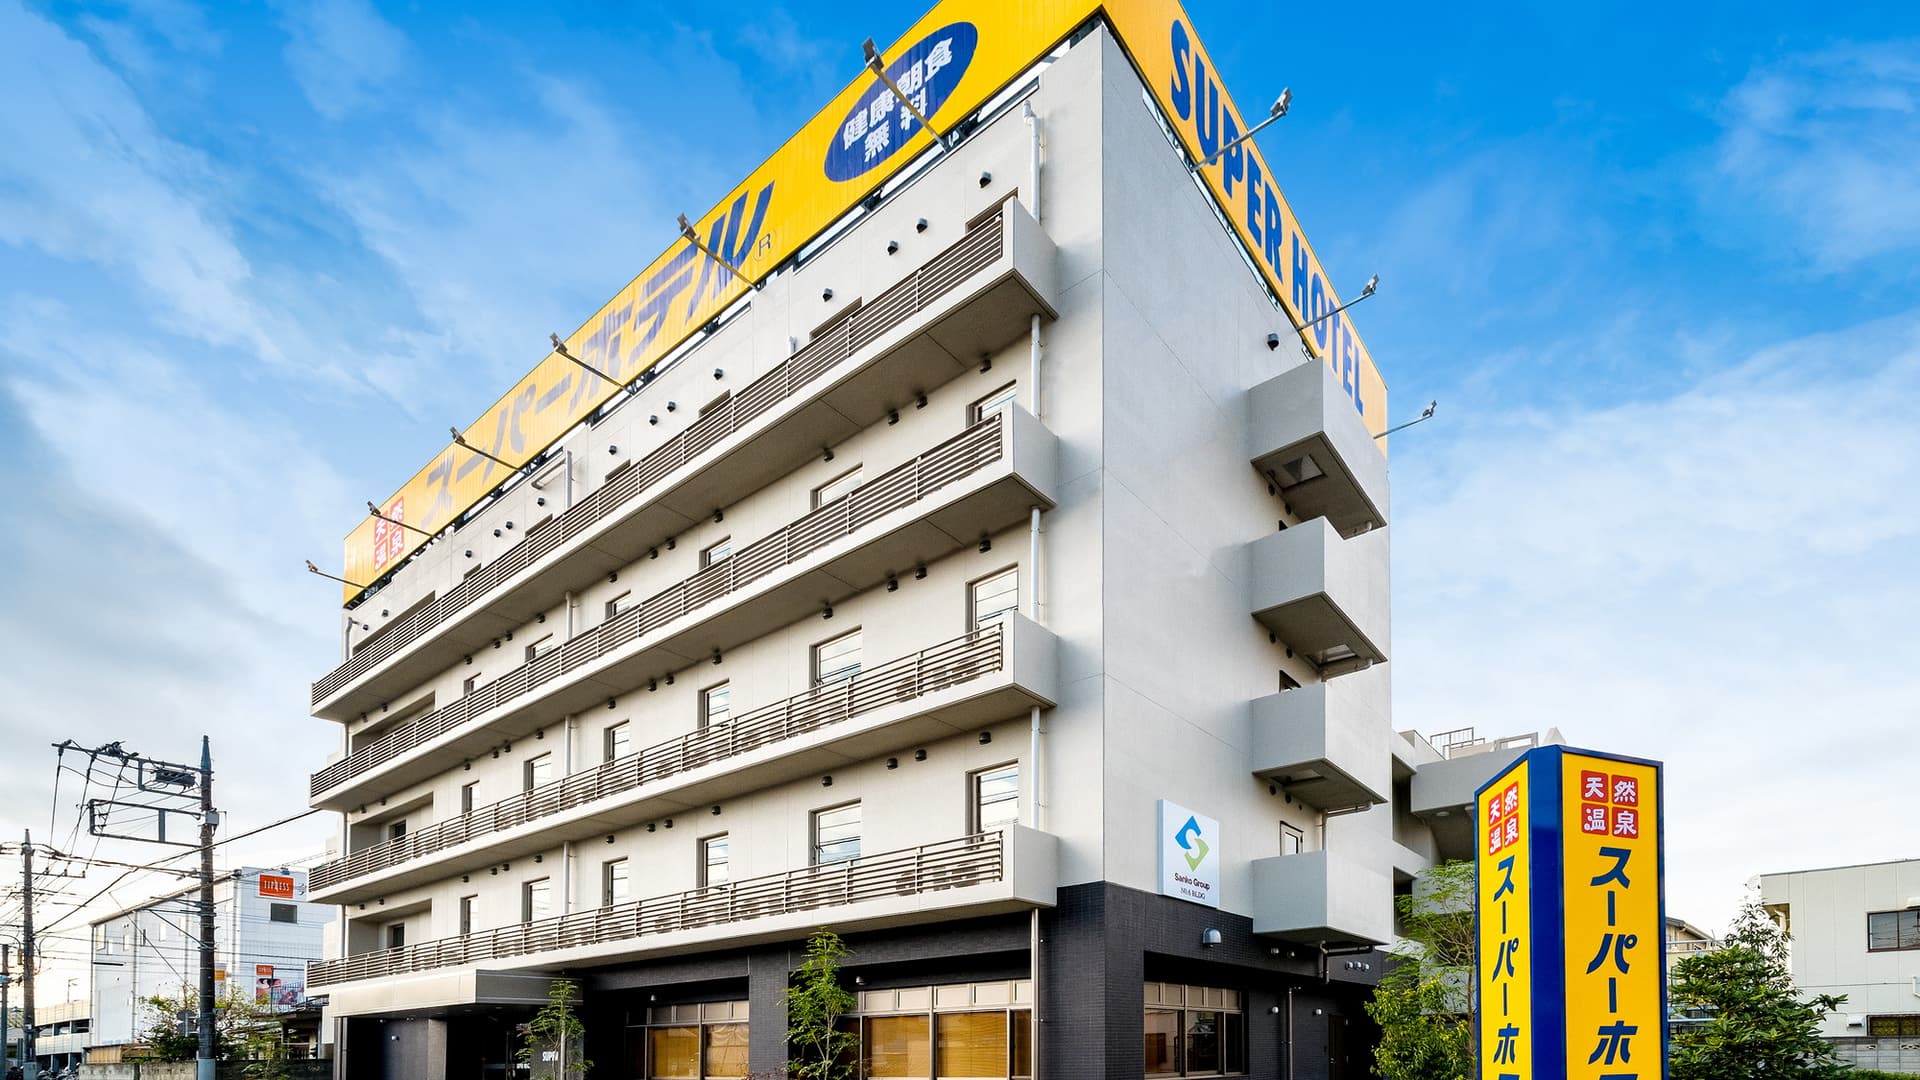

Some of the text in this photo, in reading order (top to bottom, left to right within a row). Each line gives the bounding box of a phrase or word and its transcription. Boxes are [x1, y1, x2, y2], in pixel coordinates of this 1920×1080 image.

[842, 37, 953, 151] 健康朝食
[864, 87, 927, 162] 無料
[1171, 19, 1364, 416] SUPER HOTEL
[421, 179, 775, 530] スーパーホテル
[1489, 786, 1518, 825] 天然
[1584, 777, 1636, 803] 天然
[1584, 808, 1637, 835] 温泉
[1489, 819, 1519, 854] 温泉
[1174, 872, 1210, 891] Sanko Group
[1493, 855, 1519, 1080] スーパーホ
[1586, 846, 1639, 1080] スーパーホ
